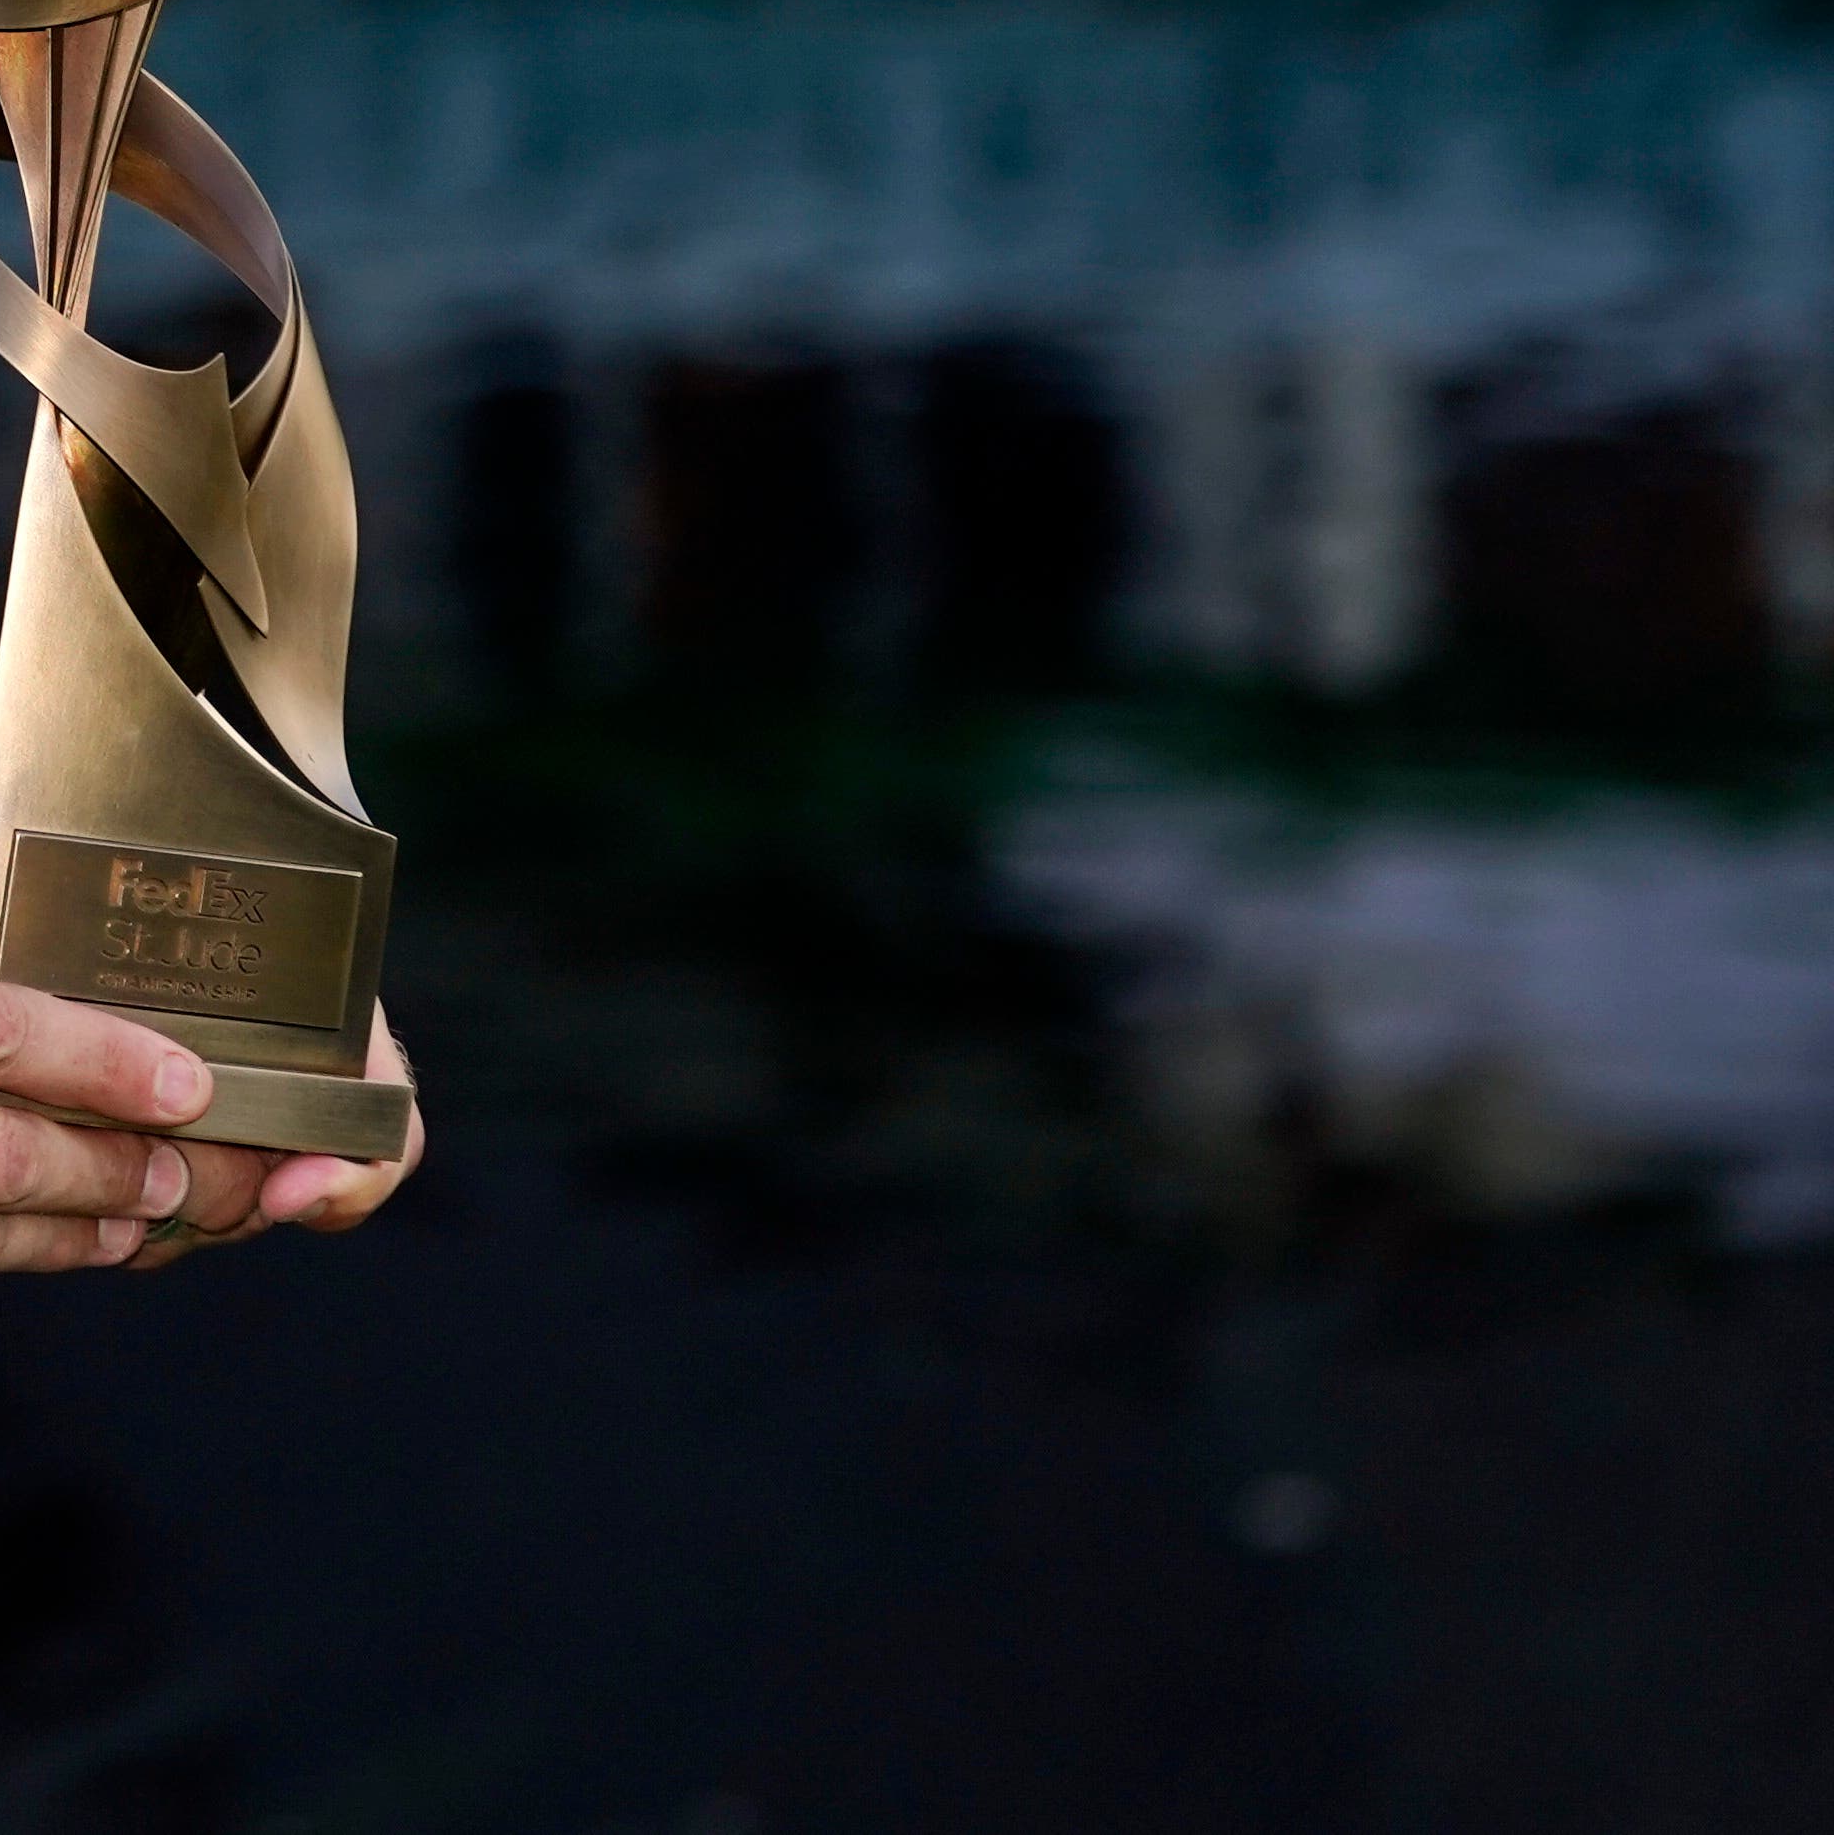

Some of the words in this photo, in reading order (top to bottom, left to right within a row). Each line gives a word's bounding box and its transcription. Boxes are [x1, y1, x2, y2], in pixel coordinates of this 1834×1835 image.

[107, 856, 268, 925] FedEx
[160, 927, 262, 976] Jude
[97, 973, 259, 1002] CHAMPIONSHIP
